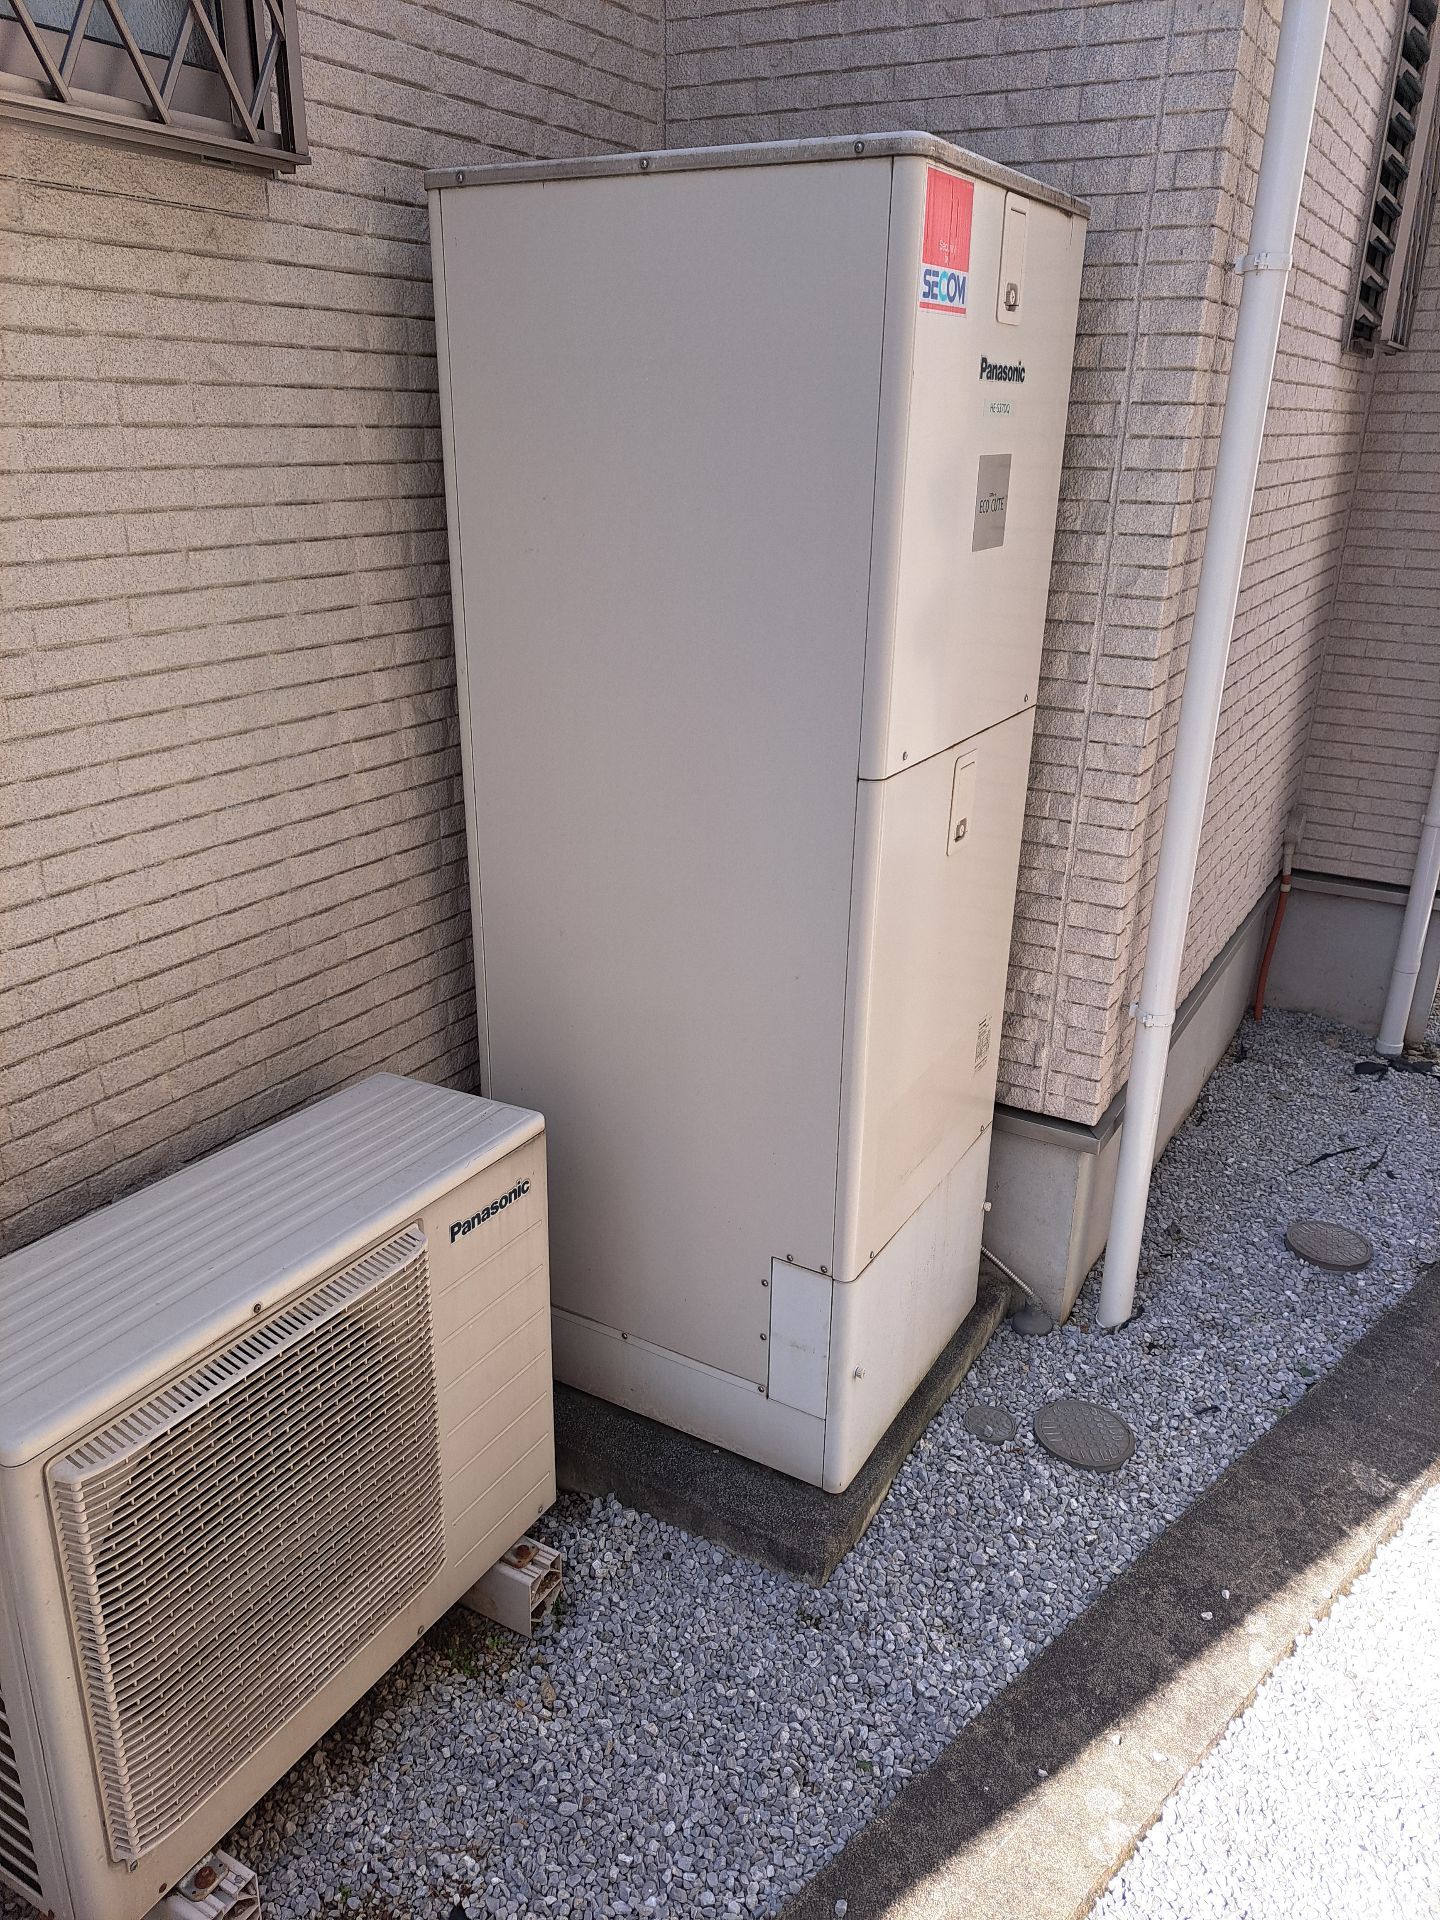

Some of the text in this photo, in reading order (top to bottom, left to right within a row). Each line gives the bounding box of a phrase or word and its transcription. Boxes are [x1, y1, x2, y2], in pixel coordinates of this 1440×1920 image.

[922, 268, 966, 305] SECOM
[979, 357, 1026, 383] Panasonic
[979, 497, 1005, 514] ECO CUTE
[450, 1180, 530, 1244] Panasonic
